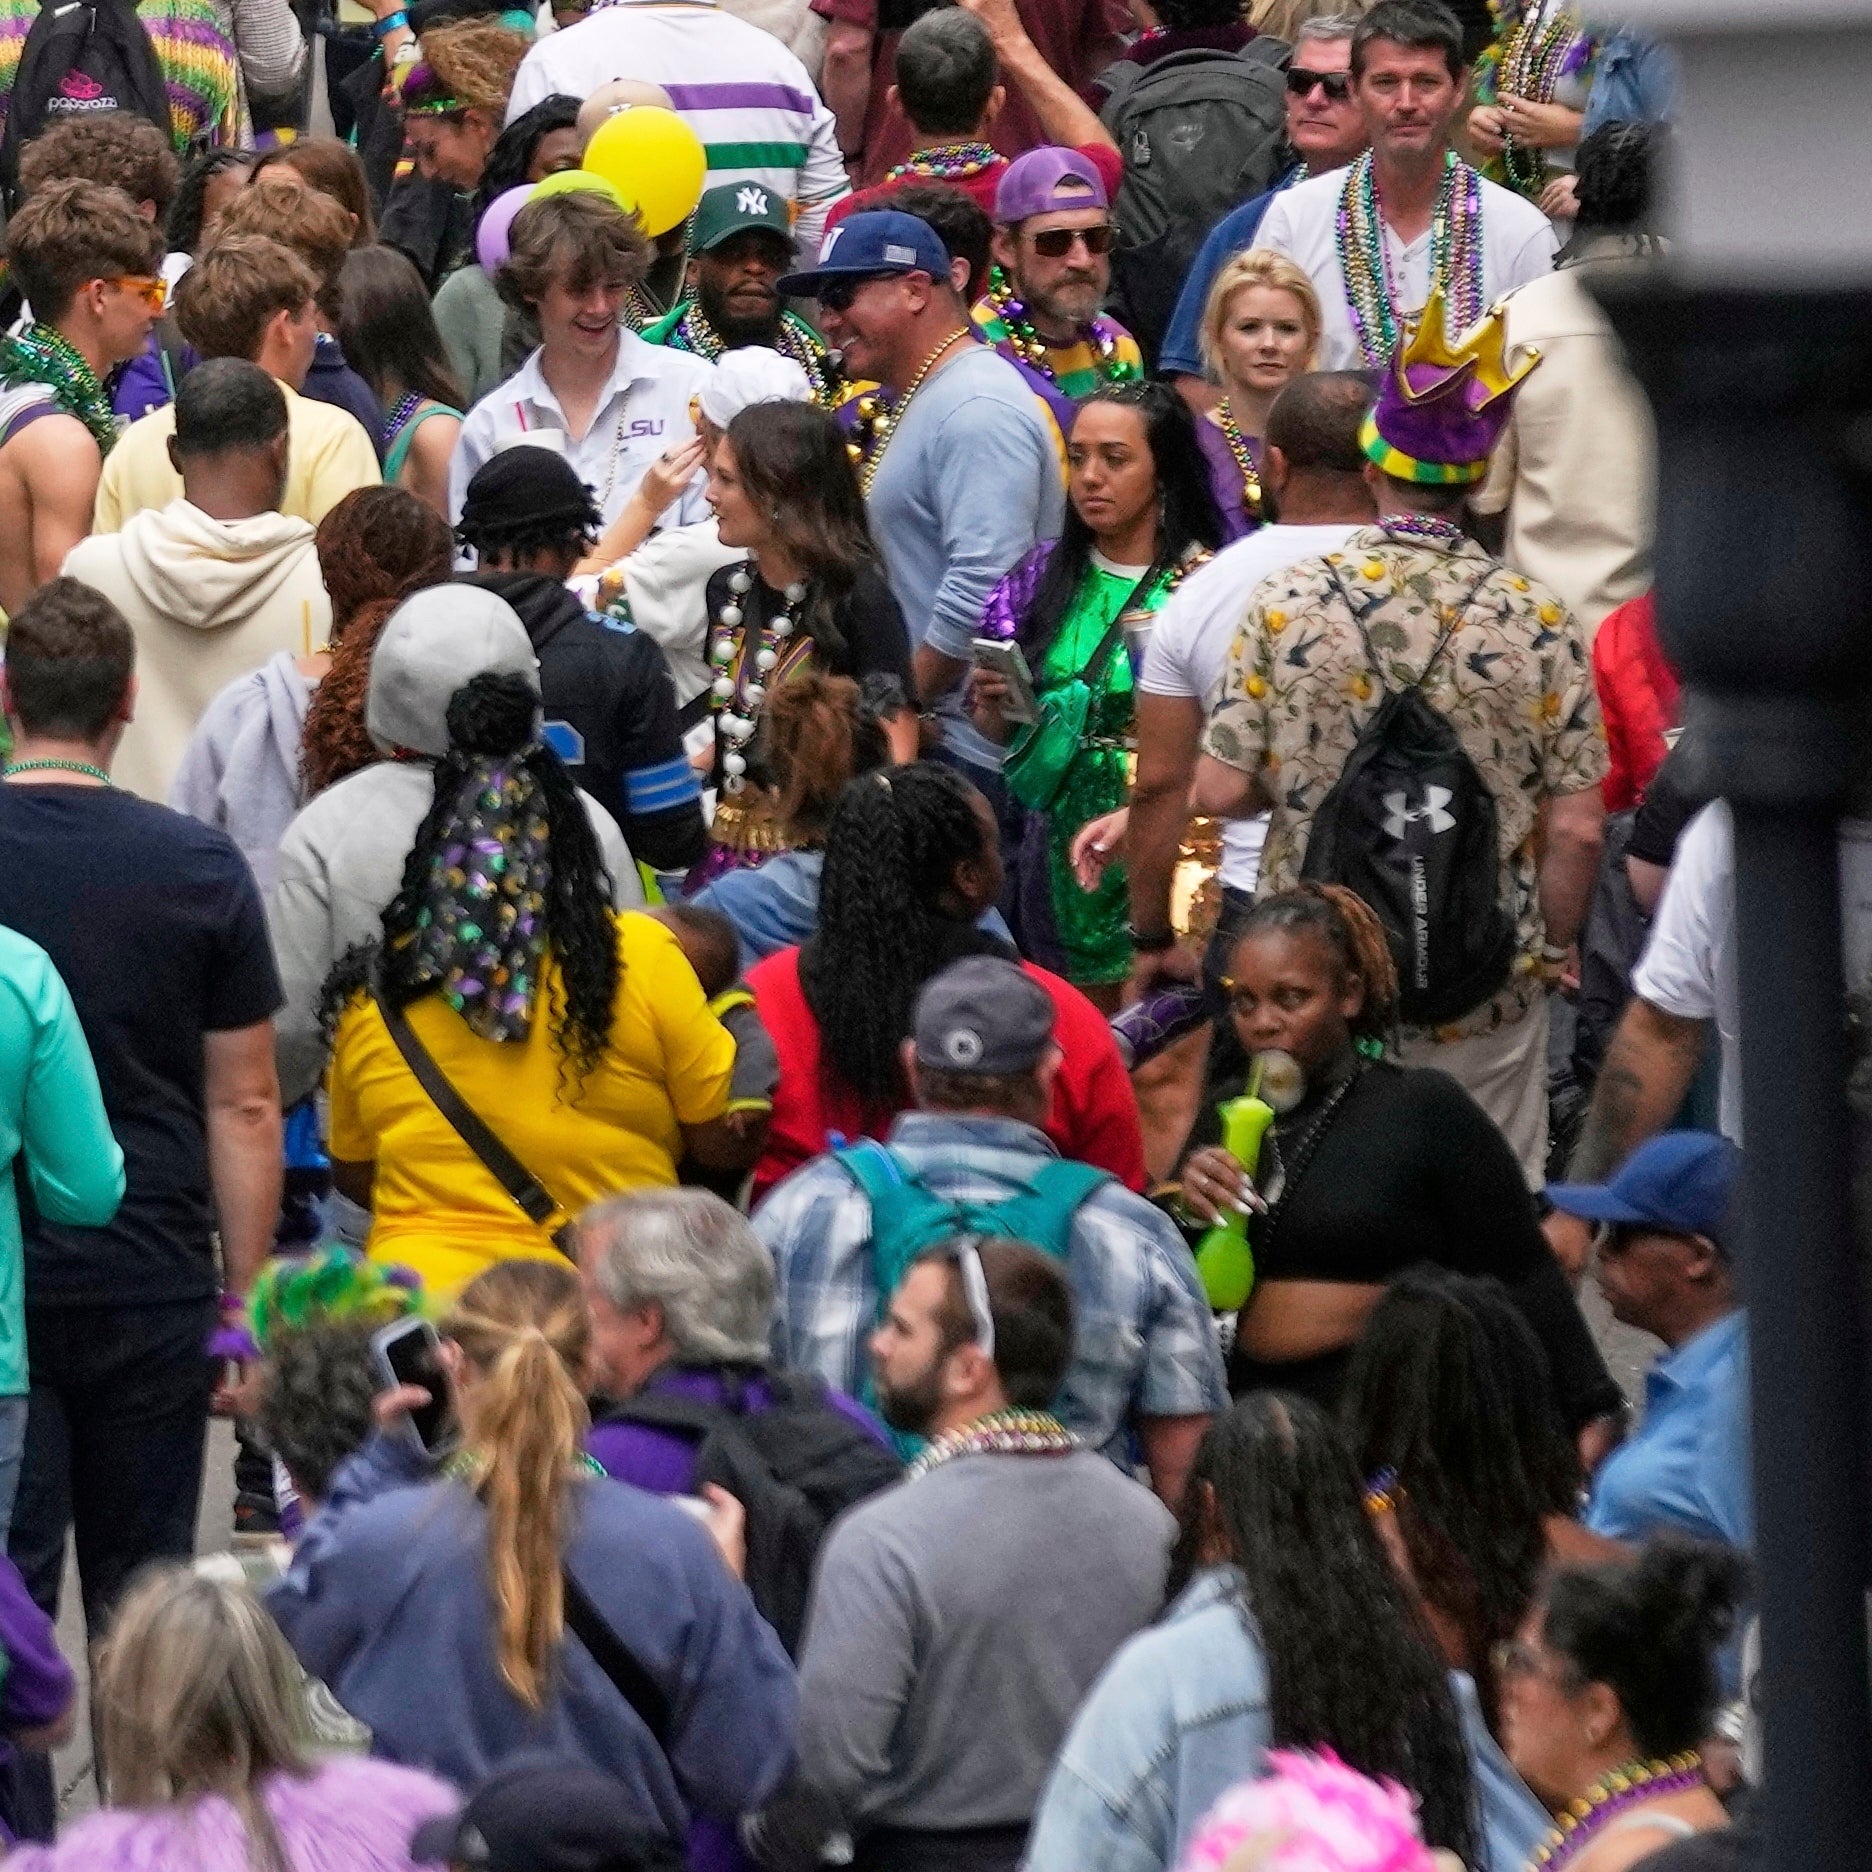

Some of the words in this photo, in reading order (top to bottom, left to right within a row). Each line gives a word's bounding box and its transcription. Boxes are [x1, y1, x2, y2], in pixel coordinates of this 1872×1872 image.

[736, 186, 769, 215] NY
[1413, 854, 1426, 915] UNDER
[1415, 916, 1429, 990] ARMOUR
